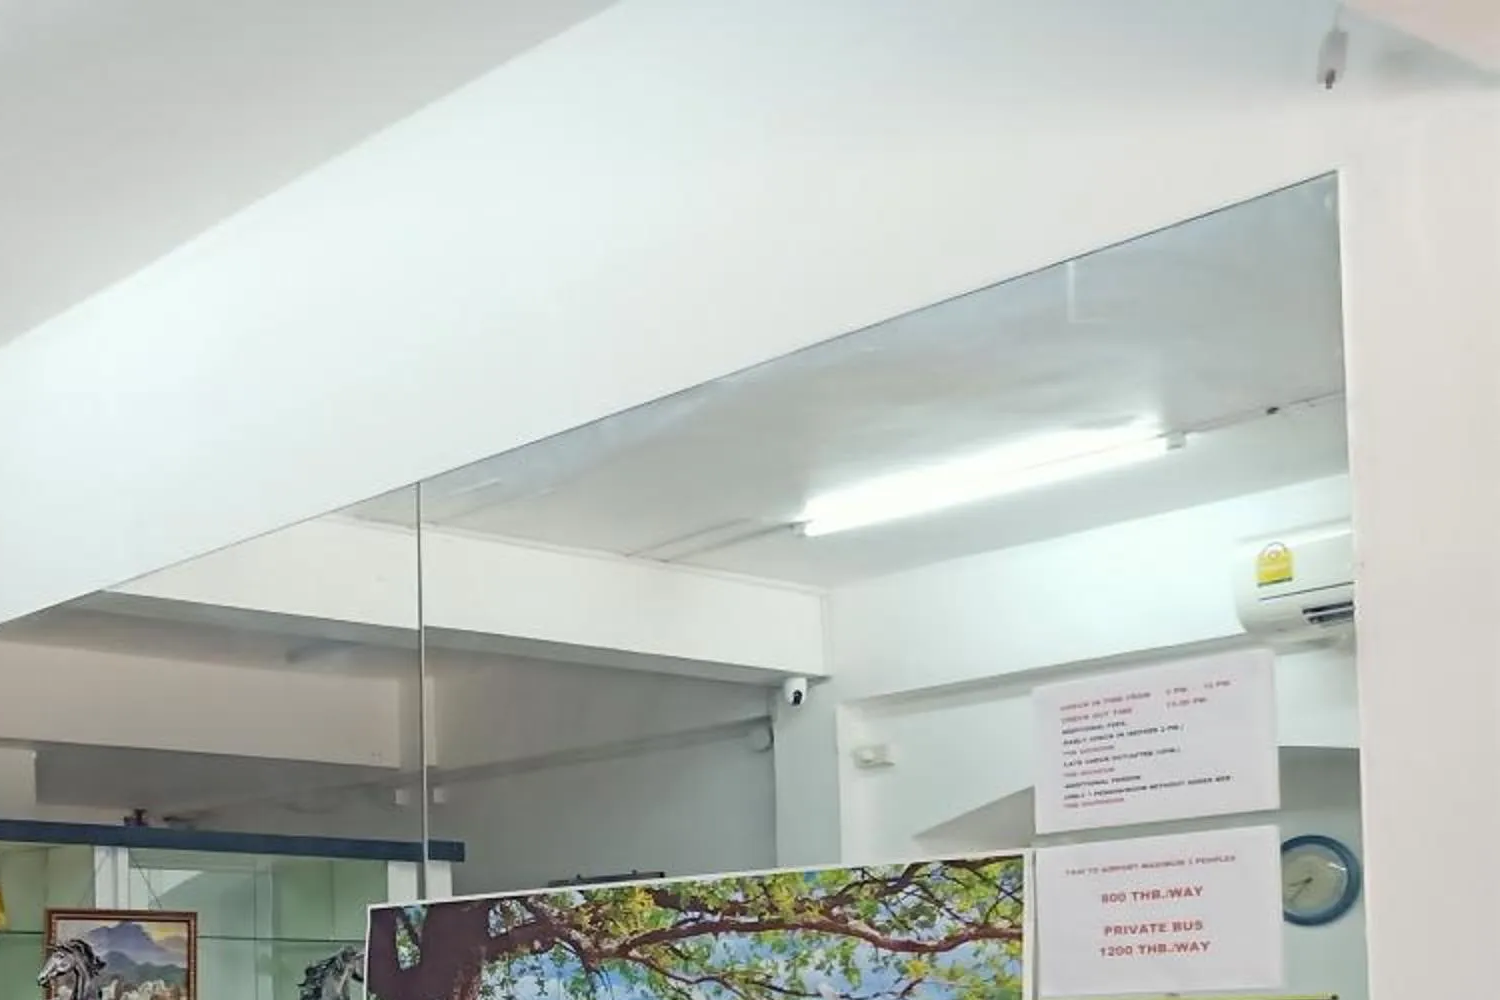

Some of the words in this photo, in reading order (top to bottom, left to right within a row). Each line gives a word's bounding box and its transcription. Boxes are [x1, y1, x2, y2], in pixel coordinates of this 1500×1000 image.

[1104, 922, 1167, 936] PRIVATE
[1172, 919, 1203, 932] BUS
[1100, 945, 1133, 957] 1200
